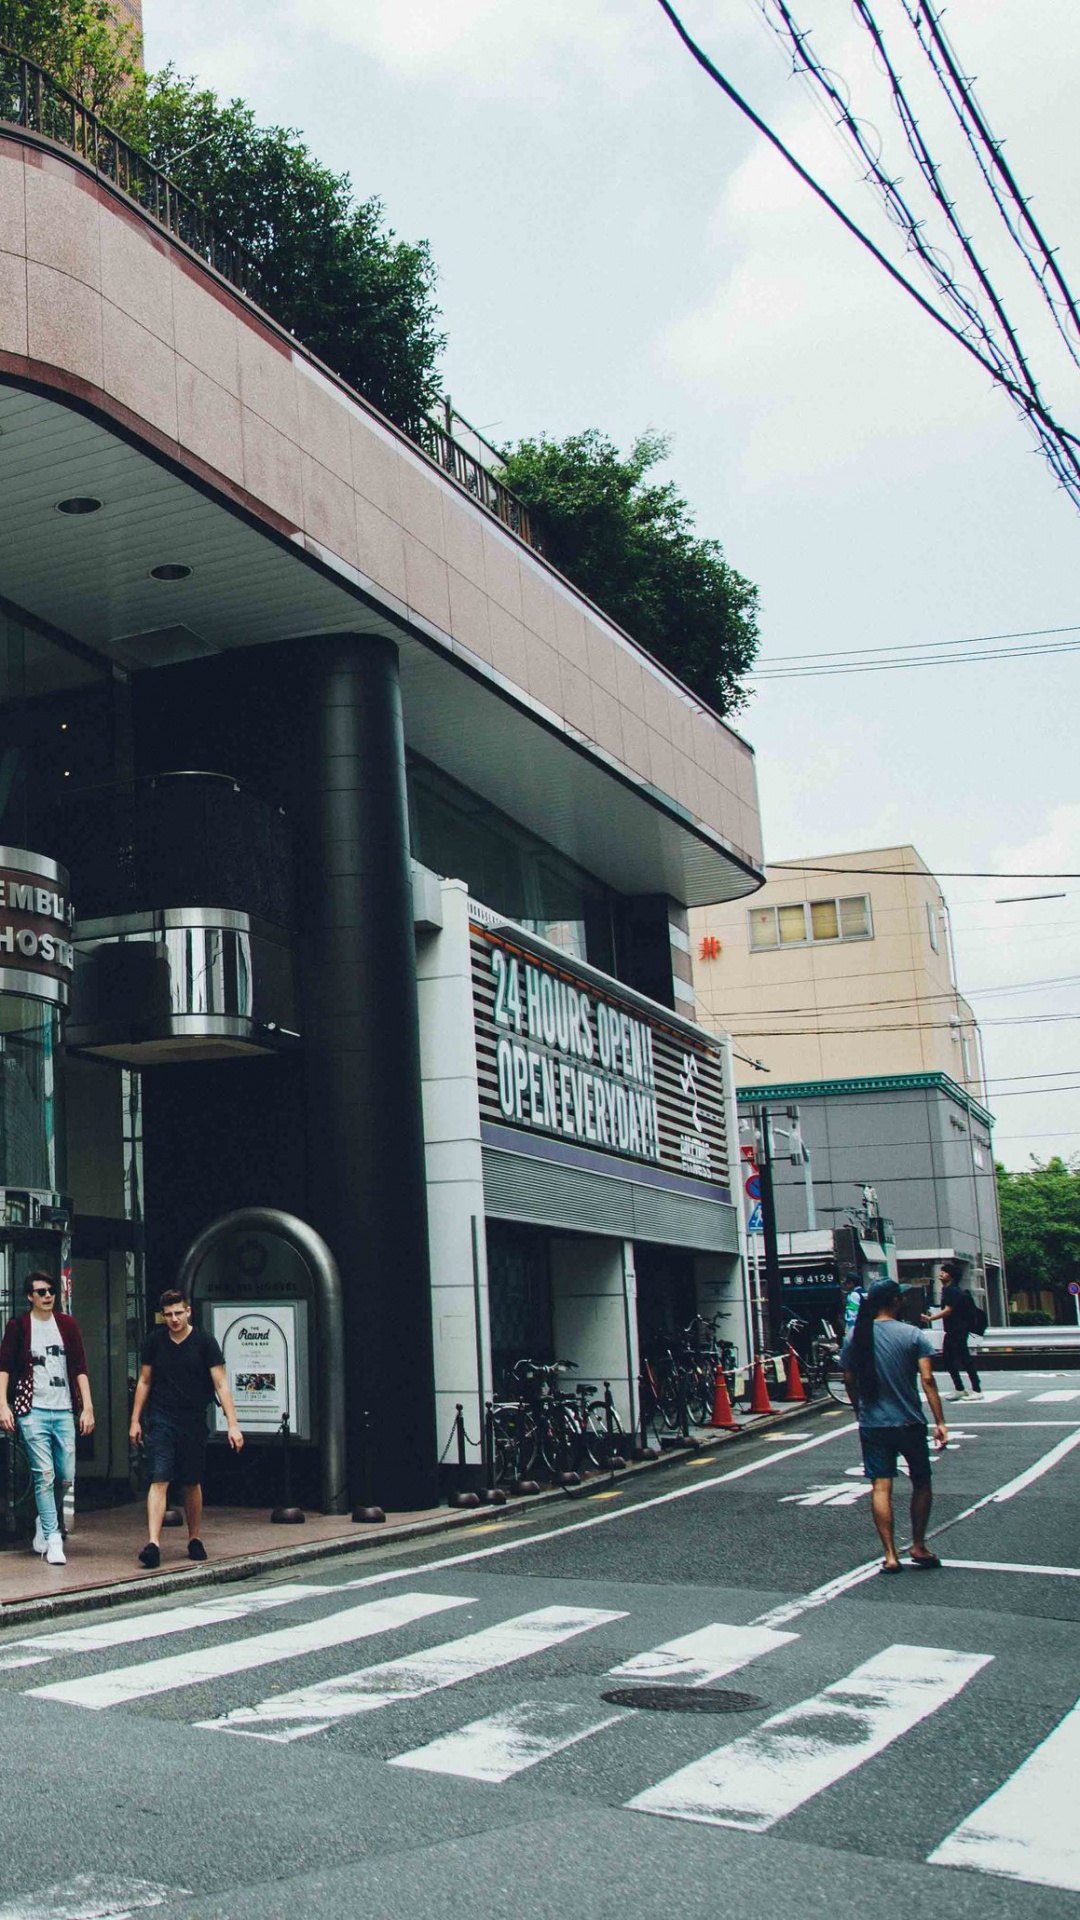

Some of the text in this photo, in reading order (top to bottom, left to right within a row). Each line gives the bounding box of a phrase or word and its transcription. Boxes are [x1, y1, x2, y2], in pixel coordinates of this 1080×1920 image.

[491, 948, 656, 1090] 24 HOURS OPEN!!
[497, 1039, 660, 1161] OPEN EVERYDAY!!
[806, 1273, 834, 1283] 4129
[238, 1327, 270, 1340] Round
